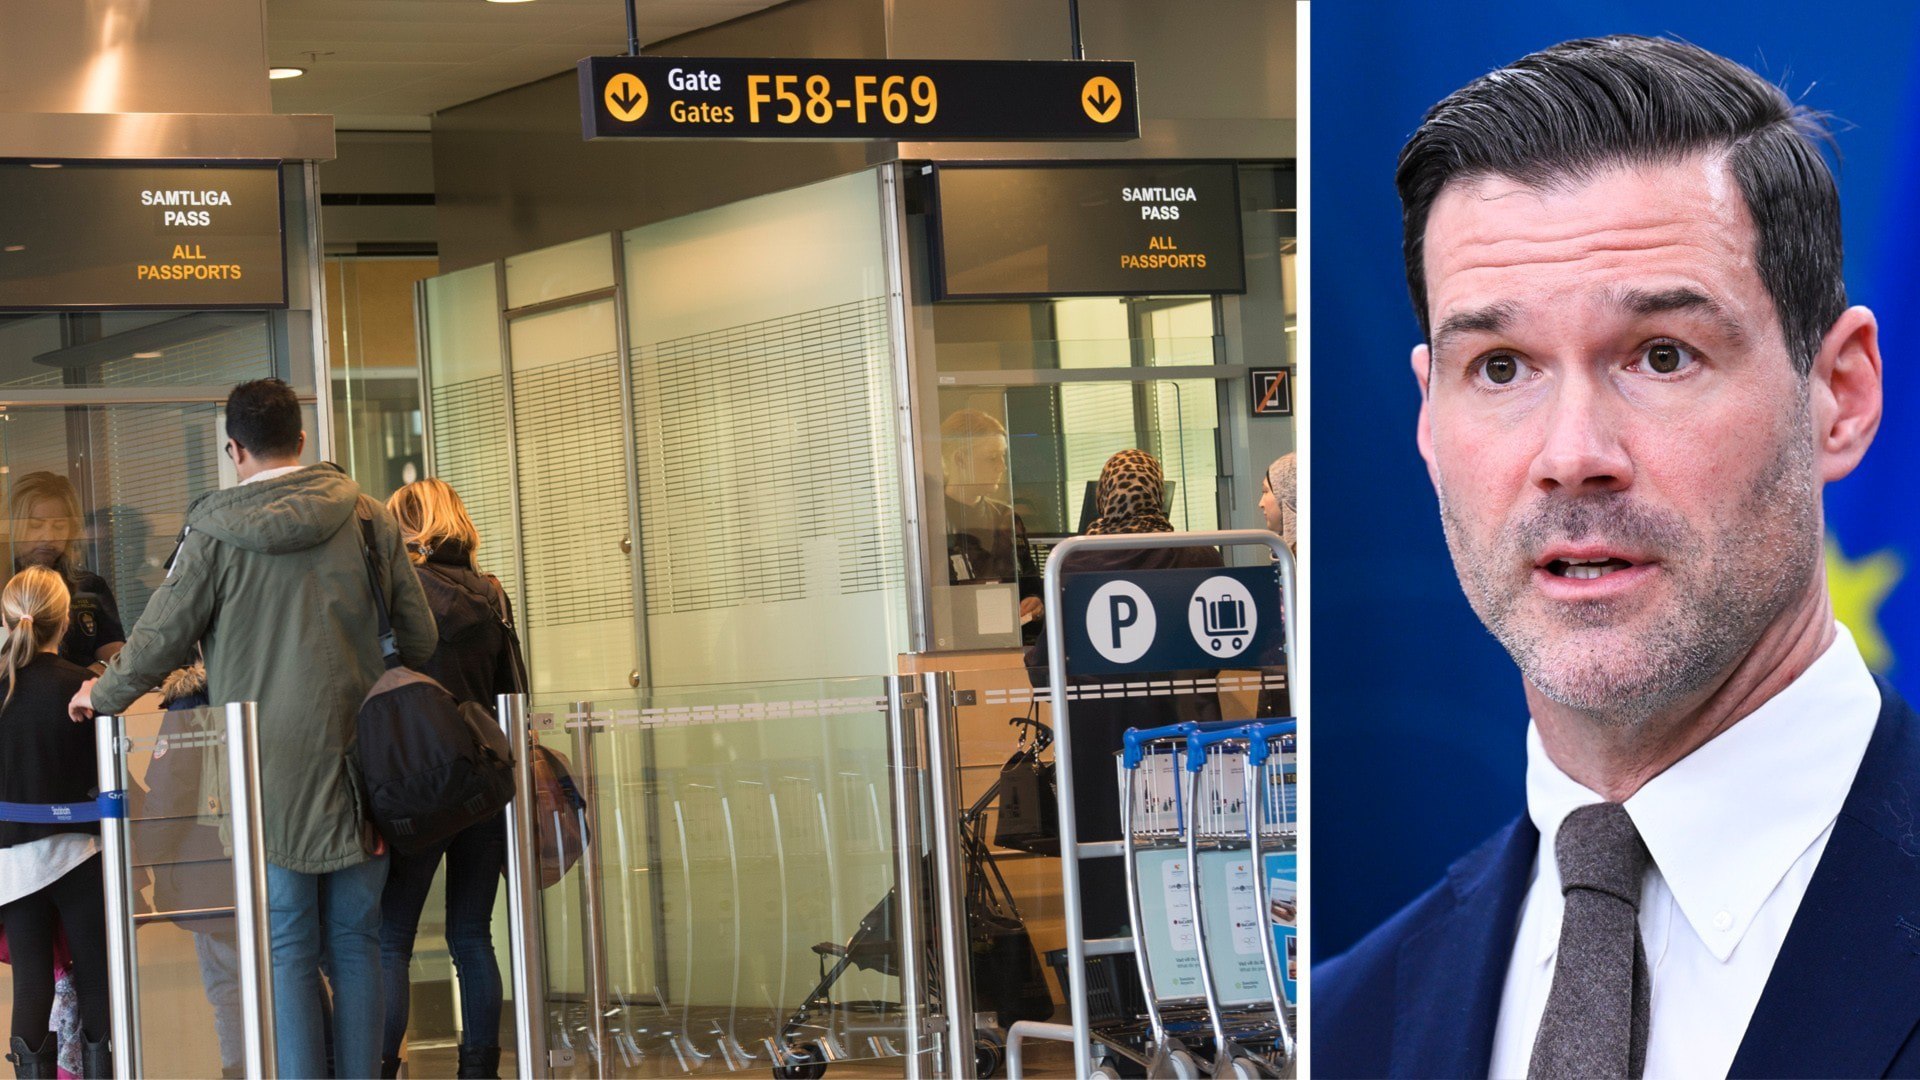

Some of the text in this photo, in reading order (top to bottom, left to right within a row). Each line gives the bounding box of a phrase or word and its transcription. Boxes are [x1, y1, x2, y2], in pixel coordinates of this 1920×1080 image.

[667, 67, 722, 93] Gate
[669, 74, 938, 125] Gates F58-F69
[141, 190, 232, 206] SAMTLIGA
[1122, 187, 1197, 203] SAMTLIGA
[164, 210, 211, 227] PASS
[1141, 205, 1180, 221] PASS
[1149, 236, 1177, 251] ALL
[171, 244, 207, 260] ALL
[1121, 254, 1207, 270] PASSPORTS
[137, 264, 242, 281] PASSPORTS
[1109, 594, 1138, 649] P
